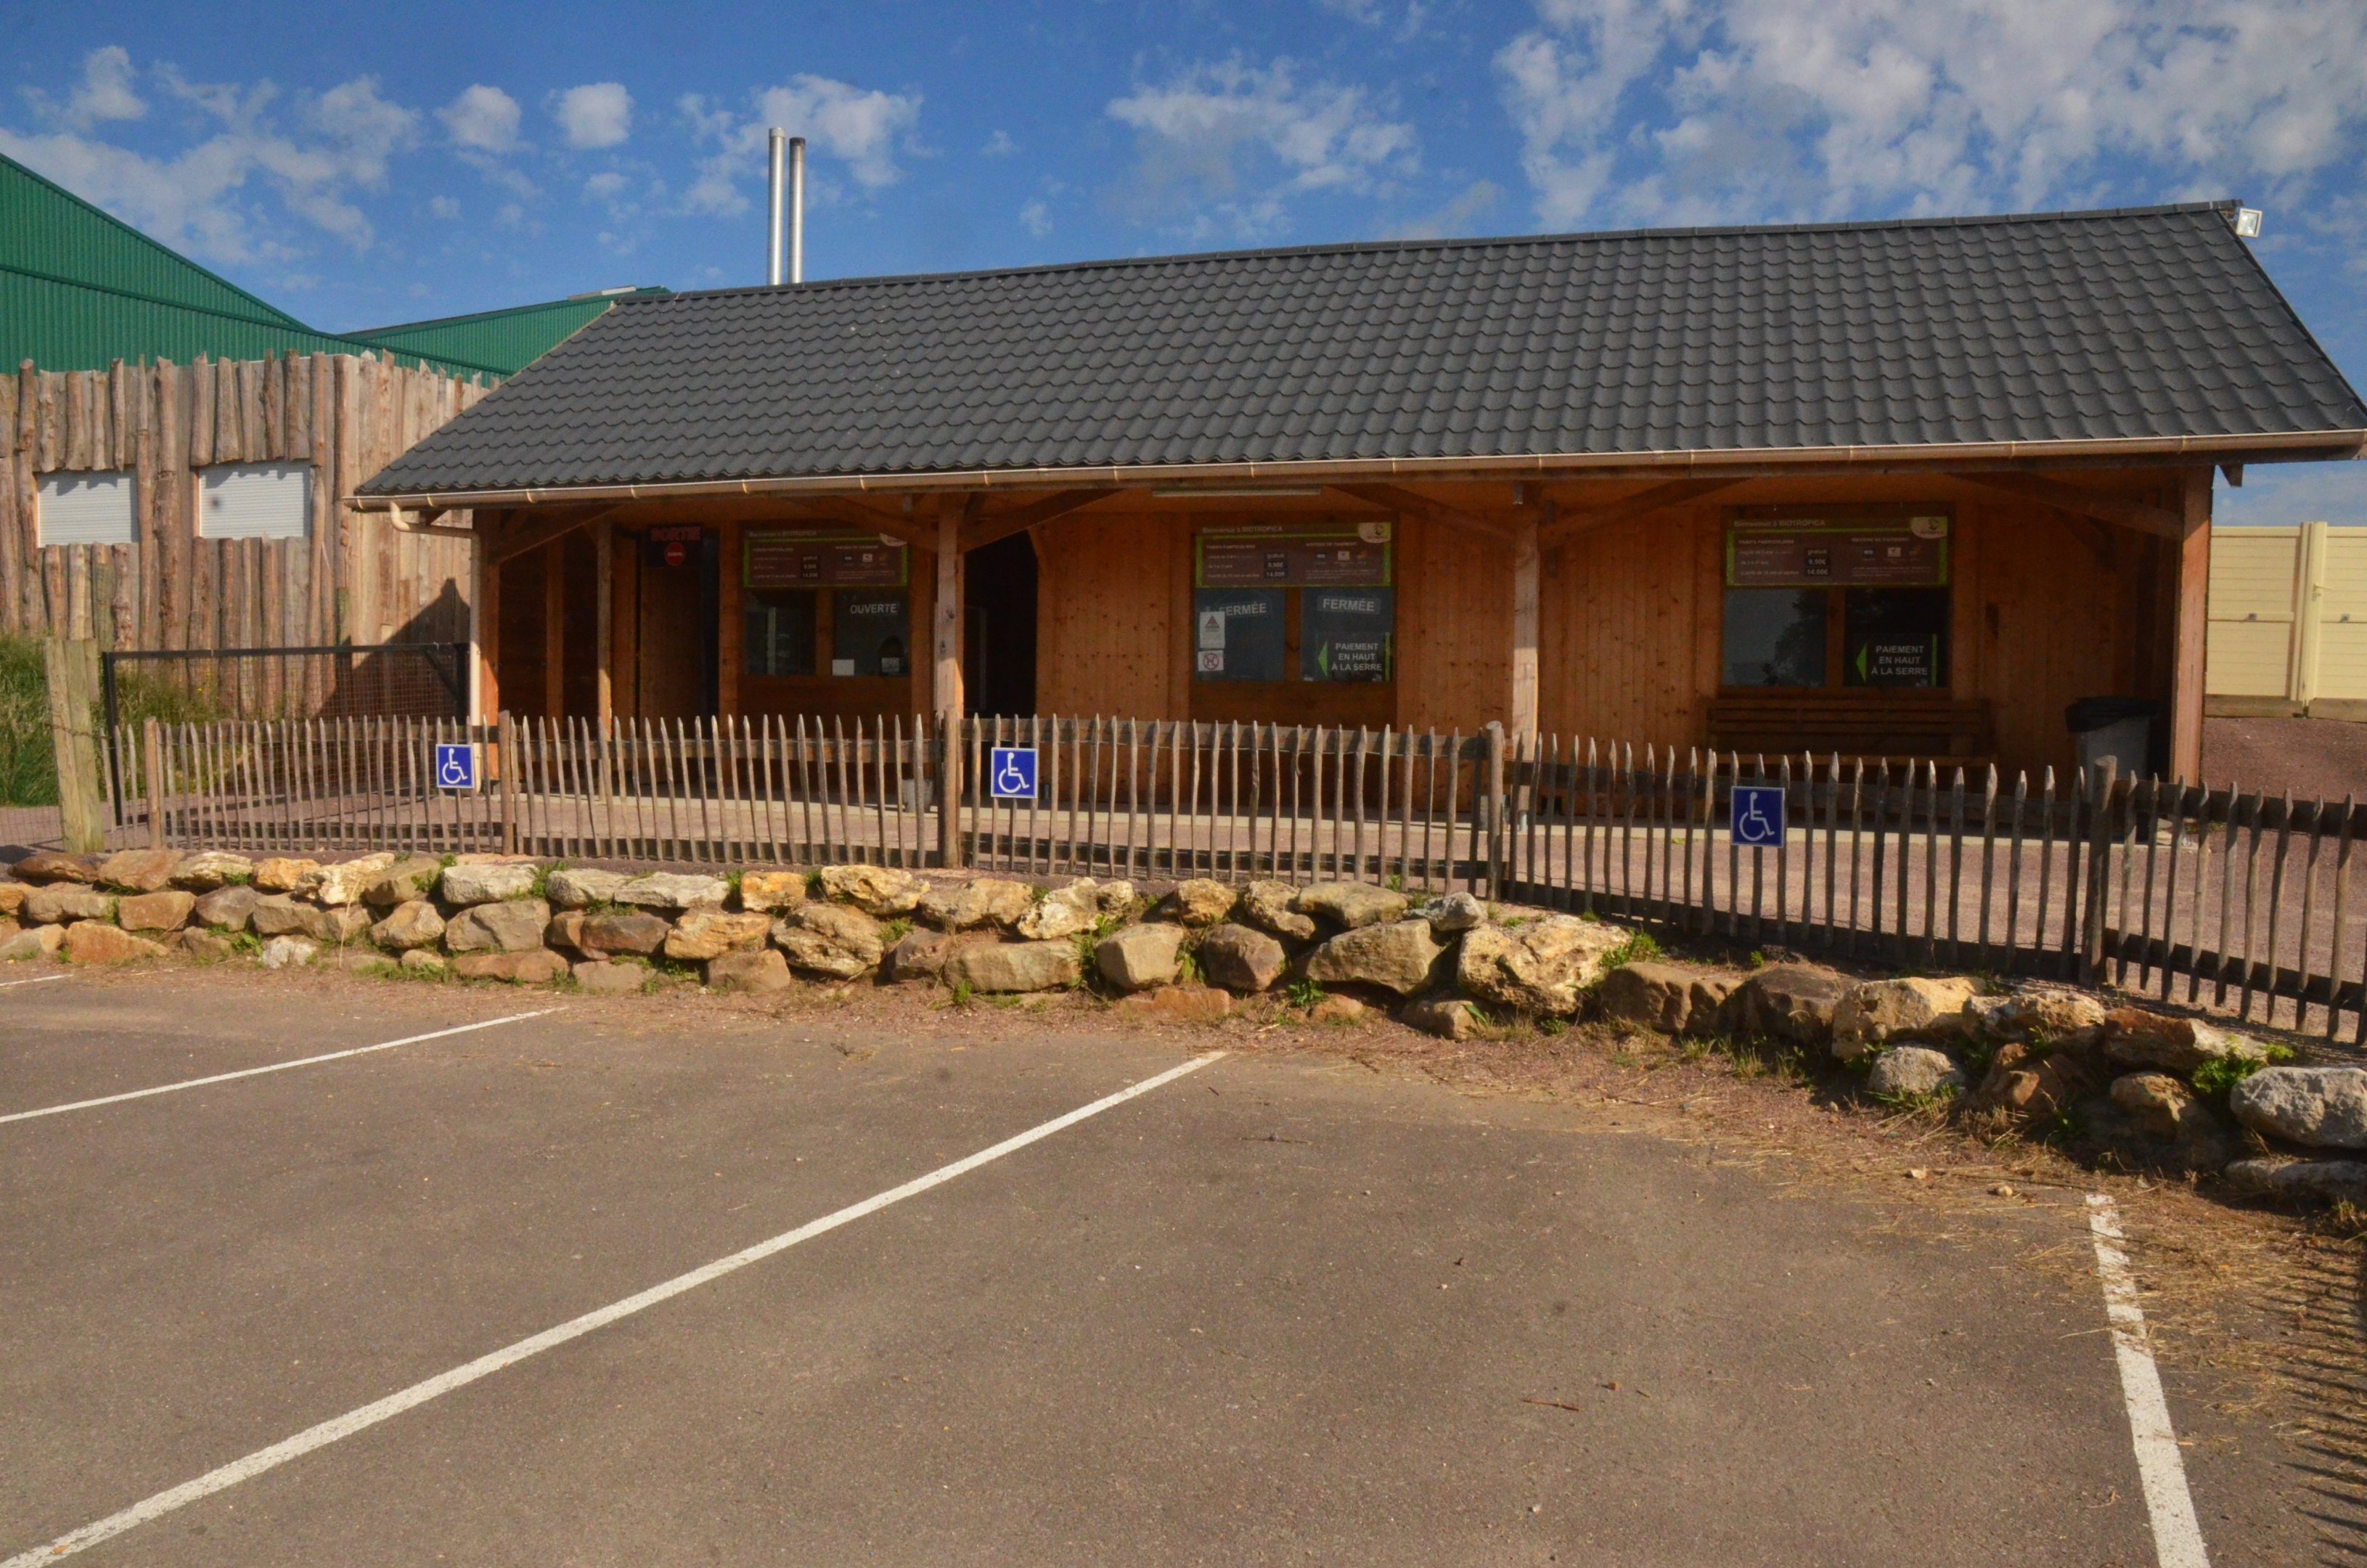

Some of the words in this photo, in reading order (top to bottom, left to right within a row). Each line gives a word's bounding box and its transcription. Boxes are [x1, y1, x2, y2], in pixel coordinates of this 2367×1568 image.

[850, 603, 898, 614] OUVERTE
[1323, 597, 1375, 612] FERMÉE
[1876, 645, 1924, 653] PAIEMENT
[1894, 656, 1921, 664] HAUT
[1331, 661, 1338, 671] À
[1353, 663, 1383, 671] SERRE
[1871, 665, 1879, 675] À
